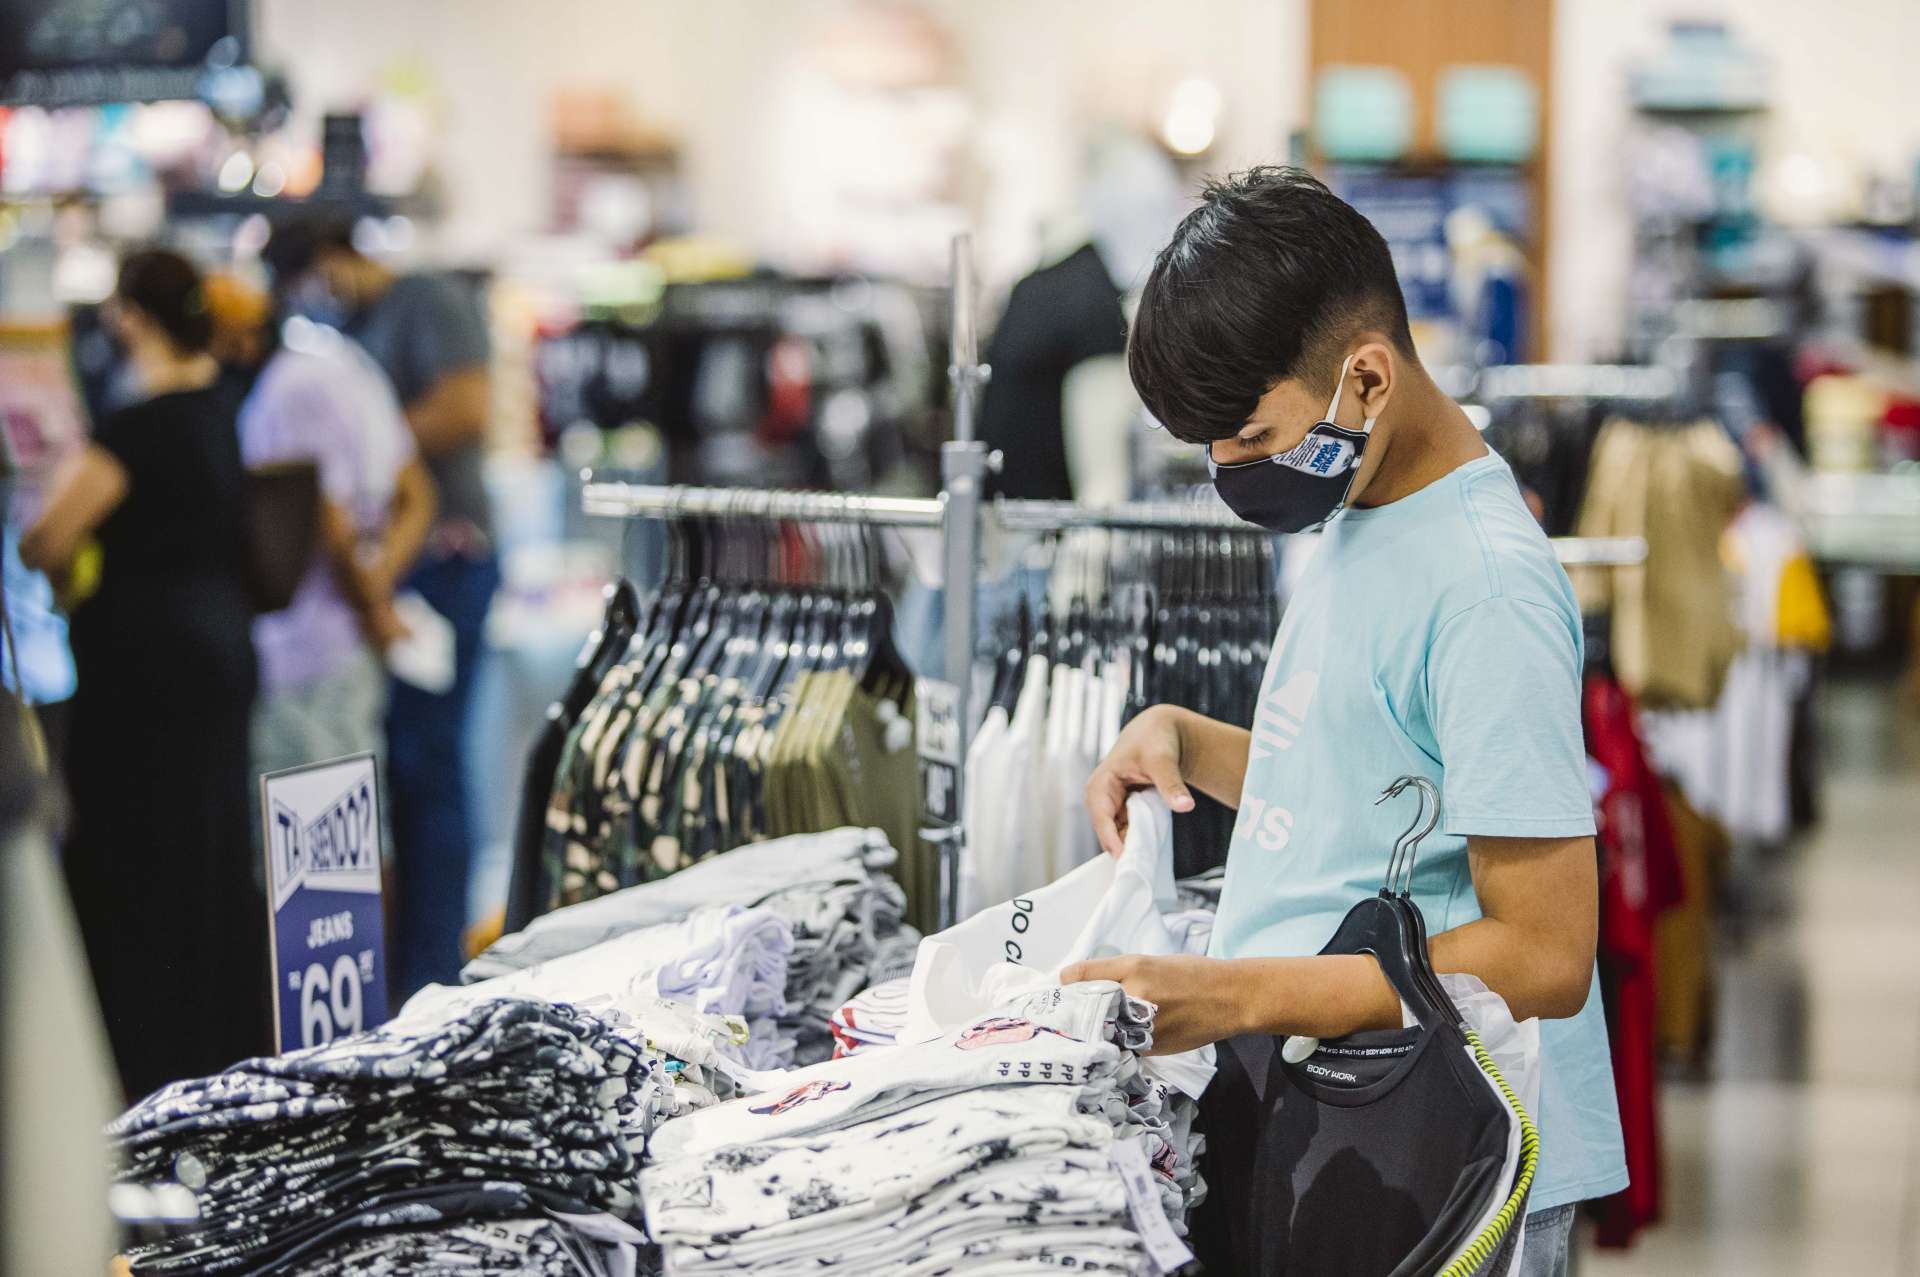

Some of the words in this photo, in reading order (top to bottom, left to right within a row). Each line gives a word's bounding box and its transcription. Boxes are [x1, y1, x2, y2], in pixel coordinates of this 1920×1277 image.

[1310, 443, 1329, 468] VODKA
[1318, 440, 1343, 474] ABSOLUT
[306, 910, 353, 949] JEANS
[1005, 939, 1023, 966] C
[301, 954, 363, 1050] 69
[1365, 1048, 1379, 1056] BODY
[1379, 1047, 1393, 1055] WORK
[1307, 1064, 1331, 1077] BODY
[1331, 1070, 1357, 1083] WORK
